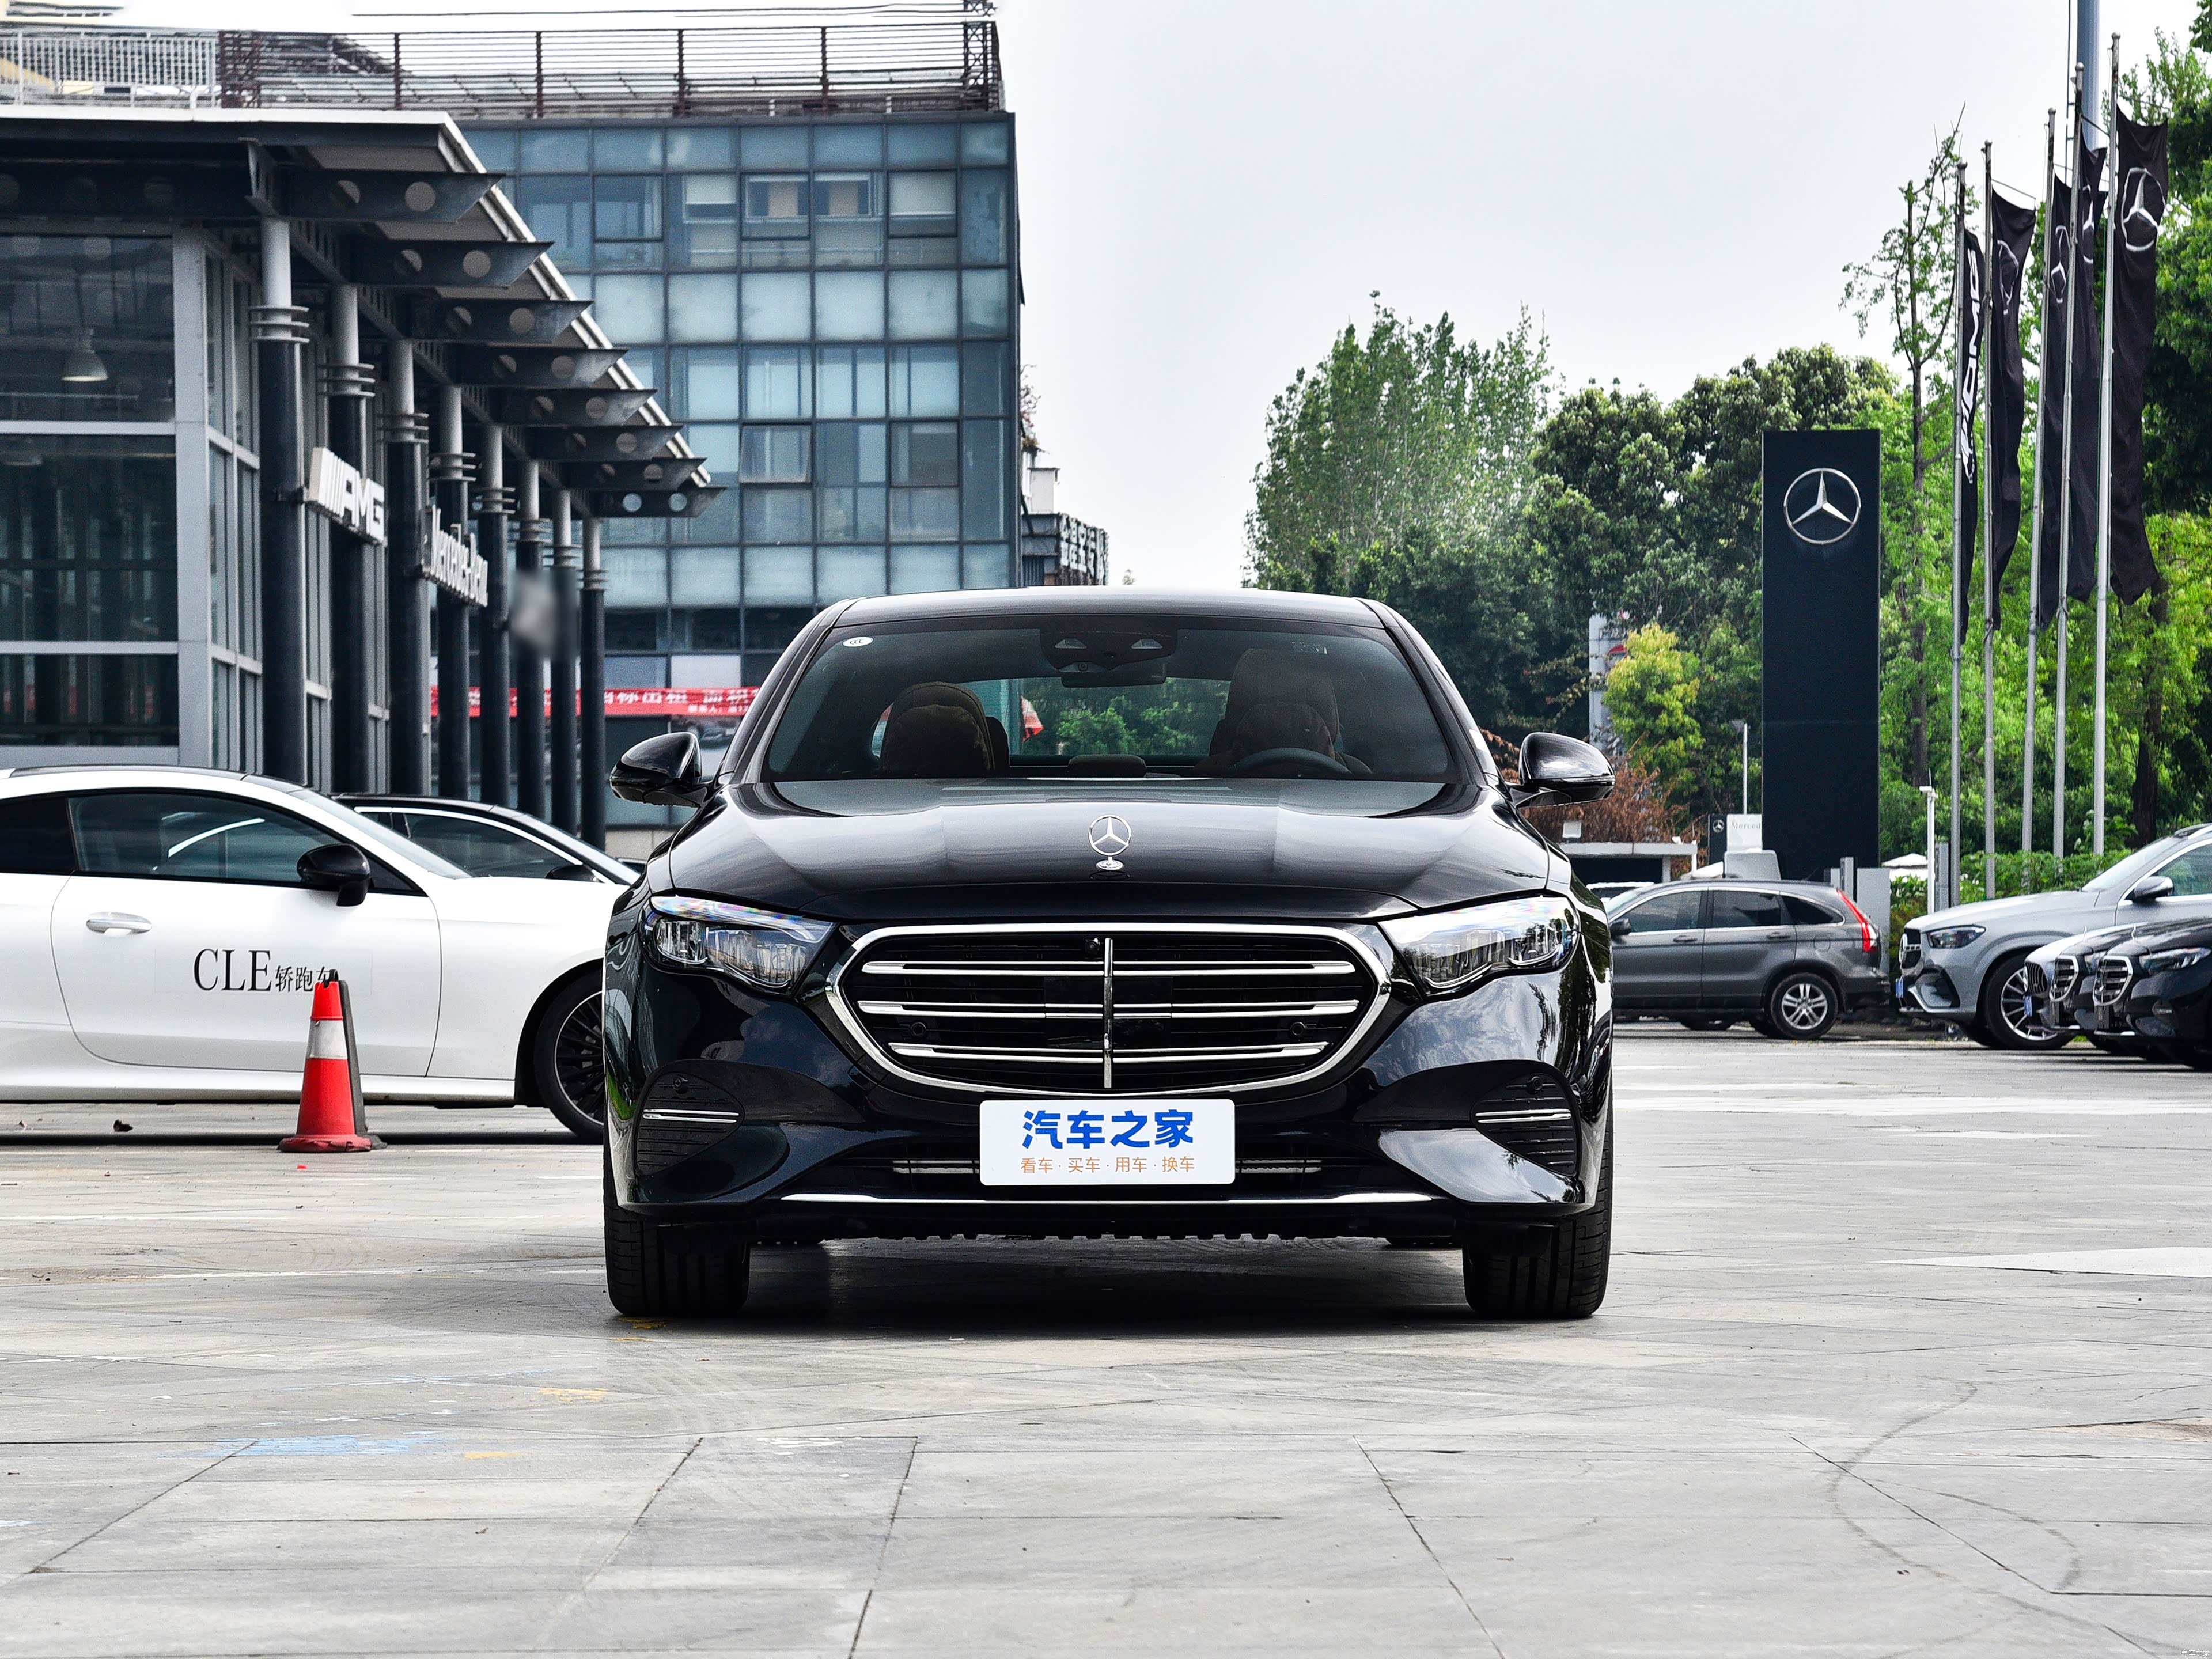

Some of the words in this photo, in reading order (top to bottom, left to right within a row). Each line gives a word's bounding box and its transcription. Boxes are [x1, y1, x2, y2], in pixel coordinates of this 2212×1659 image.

[339, 459, 385, 543] AMG
[1022, 1109, 1194, 1149] 汽车之家
